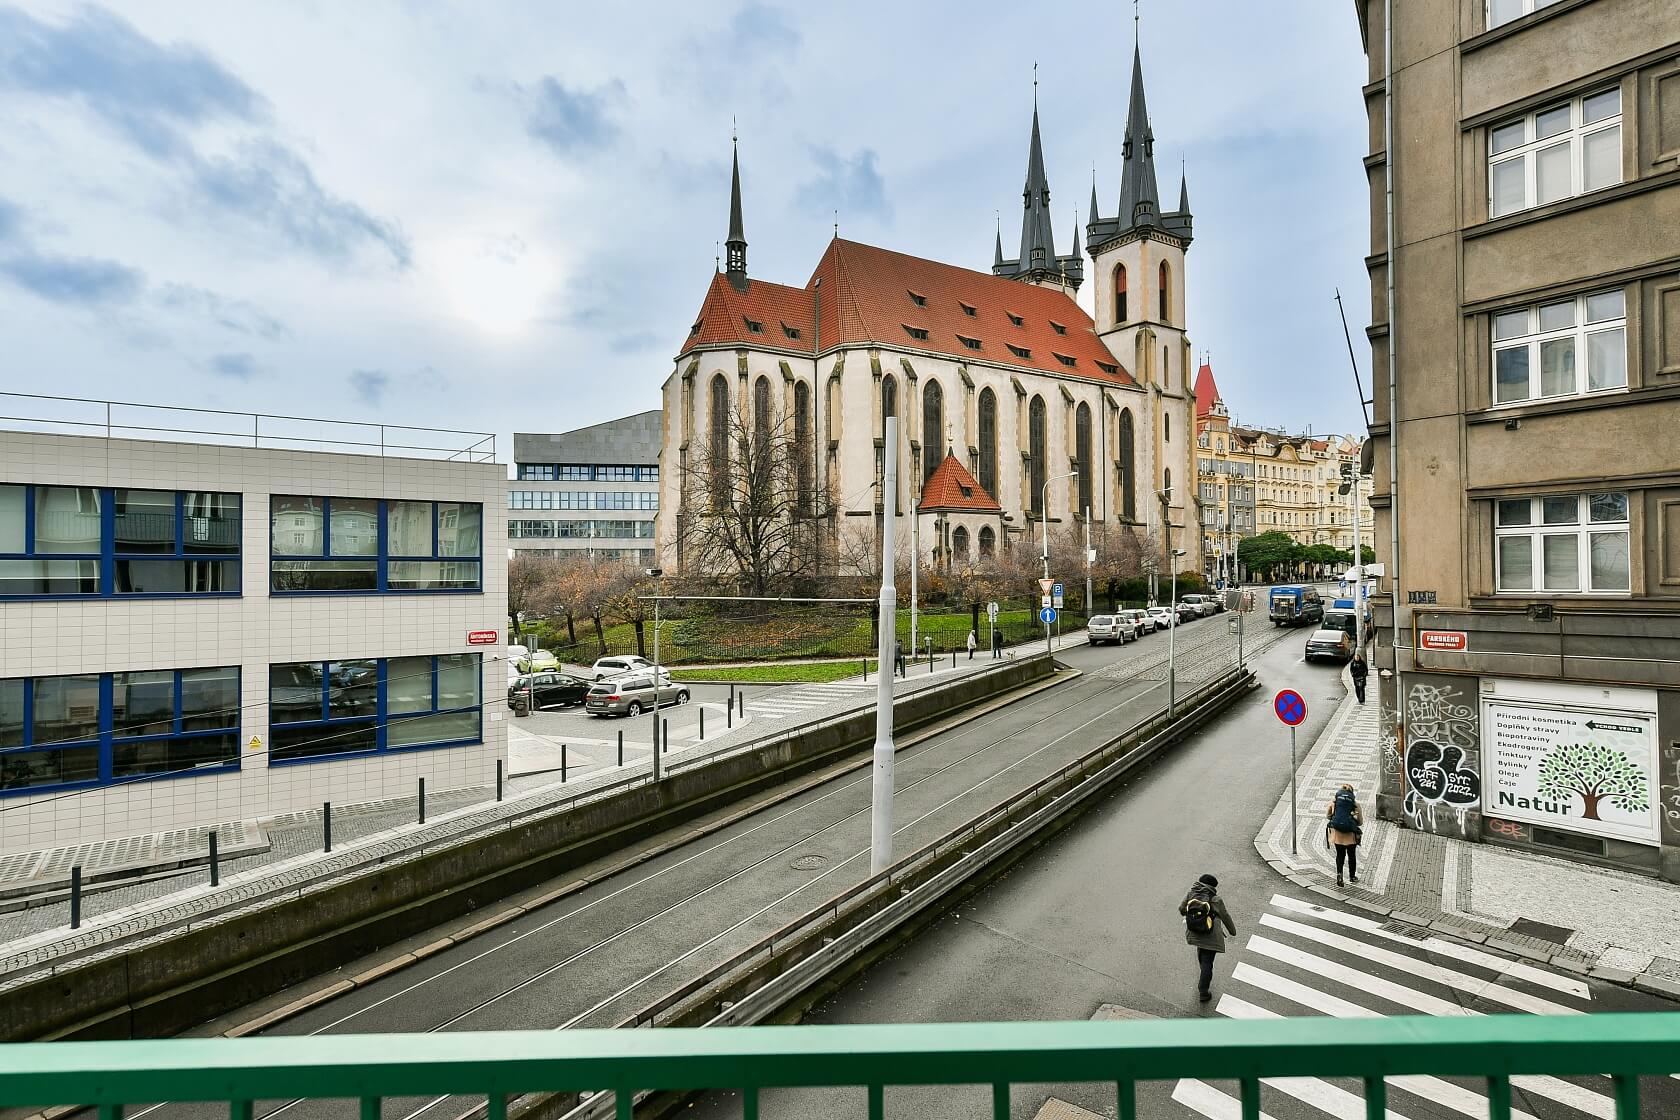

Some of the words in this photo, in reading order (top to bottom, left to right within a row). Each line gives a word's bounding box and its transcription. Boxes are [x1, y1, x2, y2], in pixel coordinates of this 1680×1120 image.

[1532, 716, 1577, 726] kosmetika
[1497, 722, 1530, 732] Doplňky
[1533, 726, 1560, 735] stravy
[1497, 731, 1550, 744] Biopotraviny
[1497, 741, 1548, 753] Ekodrogerie
[1498, 750, 1532, 761] Tinktury
[1498, 760, 1528, 770] Bylinky
[1498, 769, 1520, 778] Oleje
[1498, 791, 1572, 815] Natur
